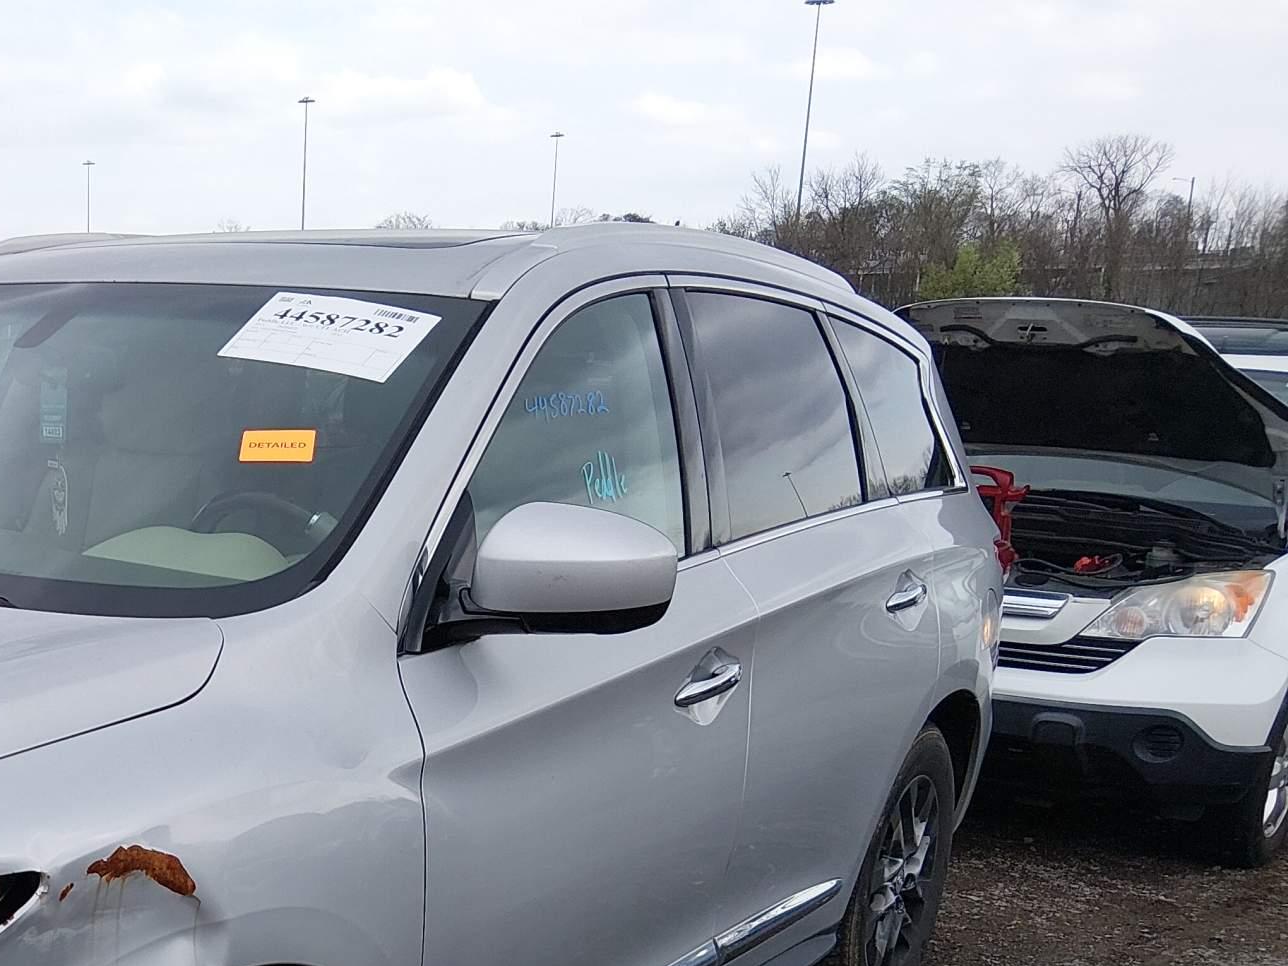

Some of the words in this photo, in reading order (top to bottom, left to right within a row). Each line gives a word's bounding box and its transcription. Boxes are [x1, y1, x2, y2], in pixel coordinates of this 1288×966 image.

[274, 307, 405, 339] 44587282
[525, 390, 609, 423] 44587282
[248, 441, 307, 449] DETAILED
